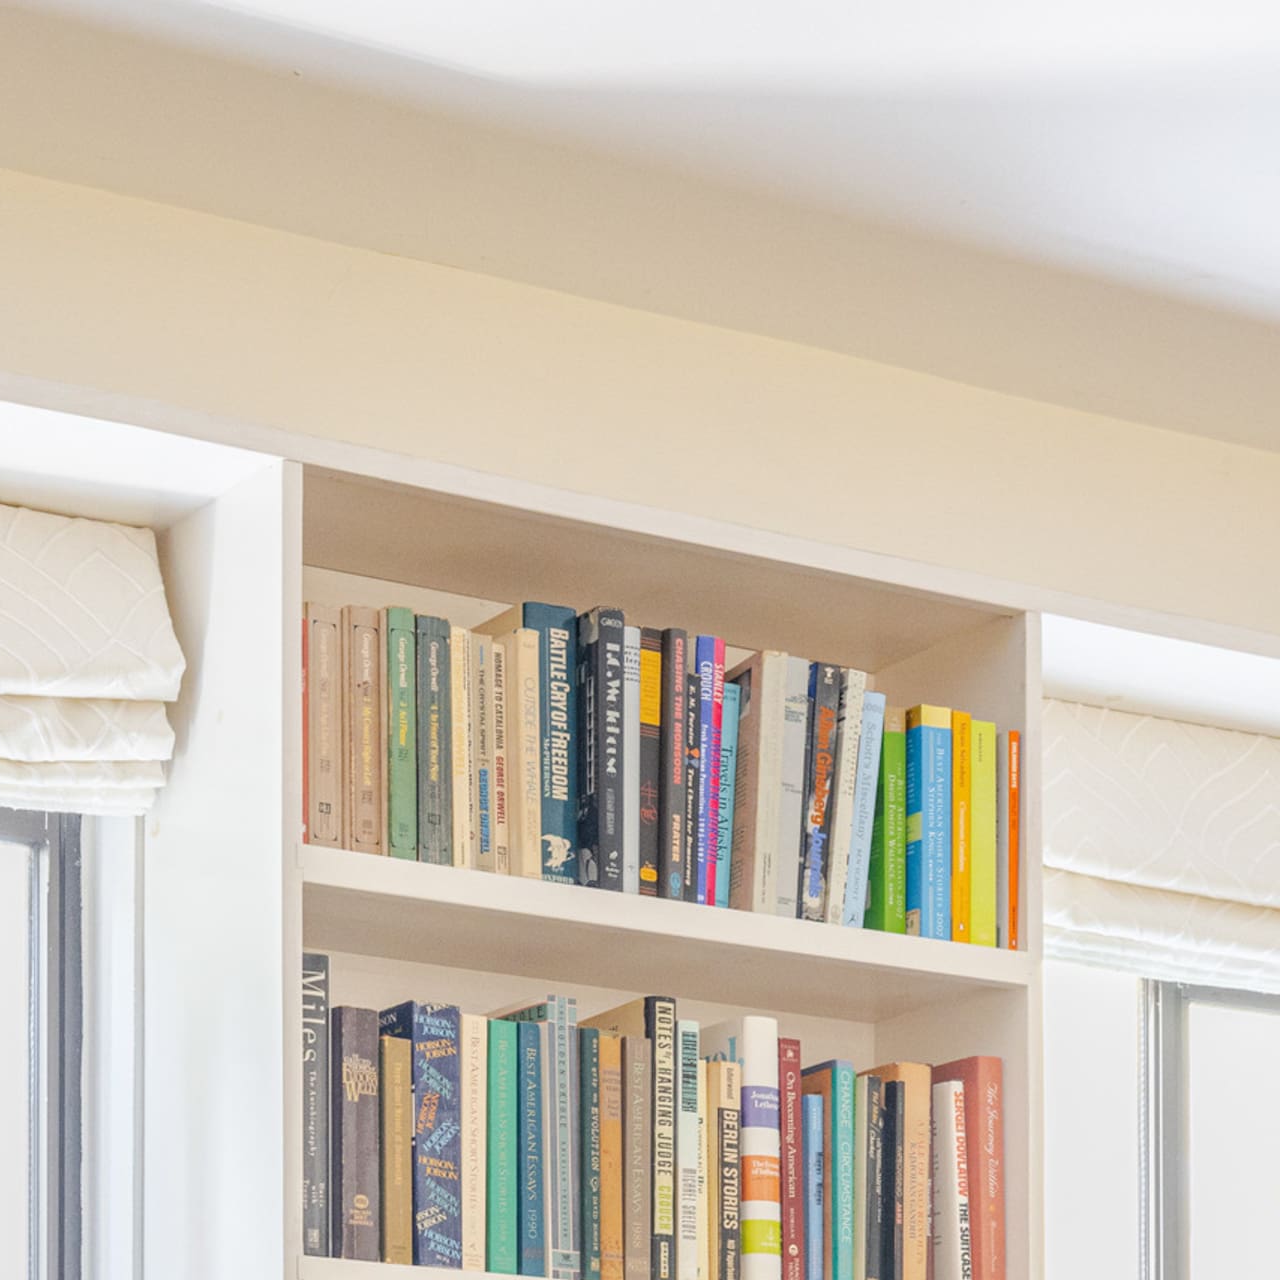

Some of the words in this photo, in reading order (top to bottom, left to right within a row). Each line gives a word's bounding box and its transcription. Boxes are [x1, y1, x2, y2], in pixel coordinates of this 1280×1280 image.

[549, 628, 569, 680] BATTLE
[673, 638, 684, 693] CHASING
[550, 680, 570, 712] CRY
[702, 661, 713, 701] CROUCH
[714, 663, 724, 704] STANLEY
[551, 713, 569, 731] OF
[673, 696, 683, 719] THE
[818, 707, 835, 749] Allen
[551, 730, 571, 802] FREEDOM
[673, 722, 683, 785] MONSOON
[718, 745, 733, 797] Travels
[936, 748, 945, 772] BEST
[719, 799, 730, 813] in
[811, 752, 834, 826] Ginsberg
[936, 775, 946, 829] AMERICAN
[672, 813, 681, 863] FRATER
[716, 815, 731, 862] Alaska
[936, 831, 946, 864] SHORT
[809, 827, 829, 900] Journals
[935, 866, 945, 909] STORIES
[302, 968, 327, 1062] Miles
[657, 1006, 672, 1049] NOTES
[309, 1070, 318, 1085] The
[526, 1047, 538, 1077] BEST
[632, 1062, 644, 1092] BEST
[786, 1070, 797, 1090] On
[527, 1081, 539, 1152] AMERICAN
[657, 1067, 672, 1127] HANGING
[785, 1091, 798, 1144] Becoming
[955, 1091, 966, 1133] SERGEI
[308, 1087, 318, 1157] Autobiography
[591, 1106, 599, 1171] EVOLUTION
[632, 1094, 645, 1164] AMERICAN
[722, 1109, 738, 1164] BERLIN
[528, 1154, 539, 1201] ESSAYS
[657, 1132, 672, 1176] JUDGE
[787, 1145, 798, 1198] American
[956, 1135, 968, 1197] DOVLATOV
[632, 1168, 643, 1213] ESSAYS
[657, 1184, 672, 1230] CROUCH
[723, 1166, 739, 1229] STORIES
[960, 1201, 969, 1224] THE
[528, 1208, 538, 1240] 1990
[632, 1221, 642, 1248] 1988
[961, 1226, 972, 1280] SUITCASE
